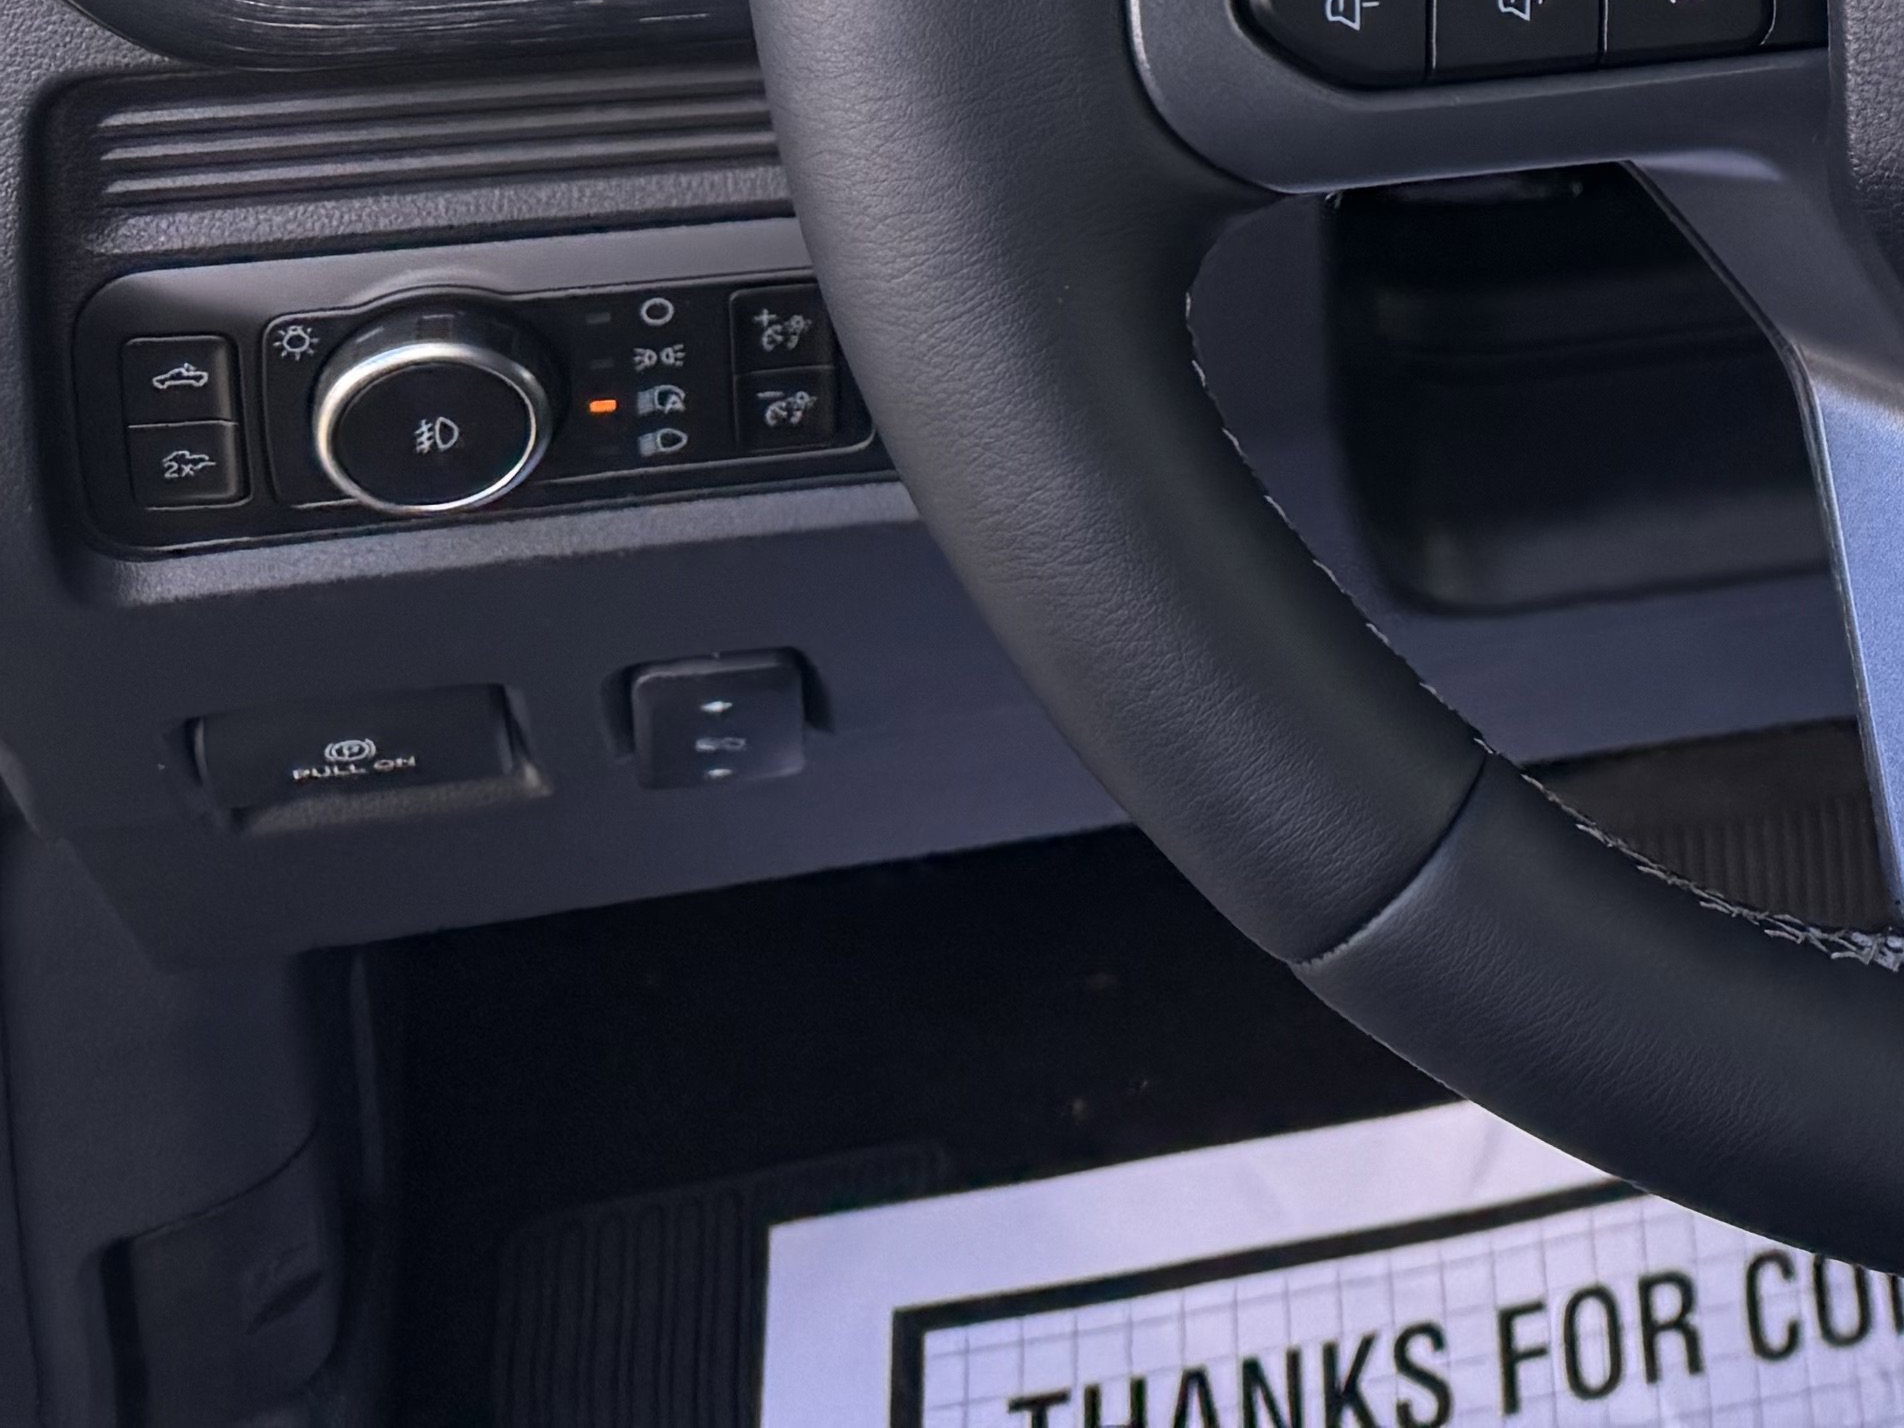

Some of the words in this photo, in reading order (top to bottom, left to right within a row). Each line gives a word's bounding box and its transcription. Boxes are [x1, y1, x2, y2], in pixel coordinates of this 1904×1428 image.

[292, 763, 367, 780] PULL
[372, 755, 417, 773] ON
[1496, 1270, 1704, 1415] FOR
